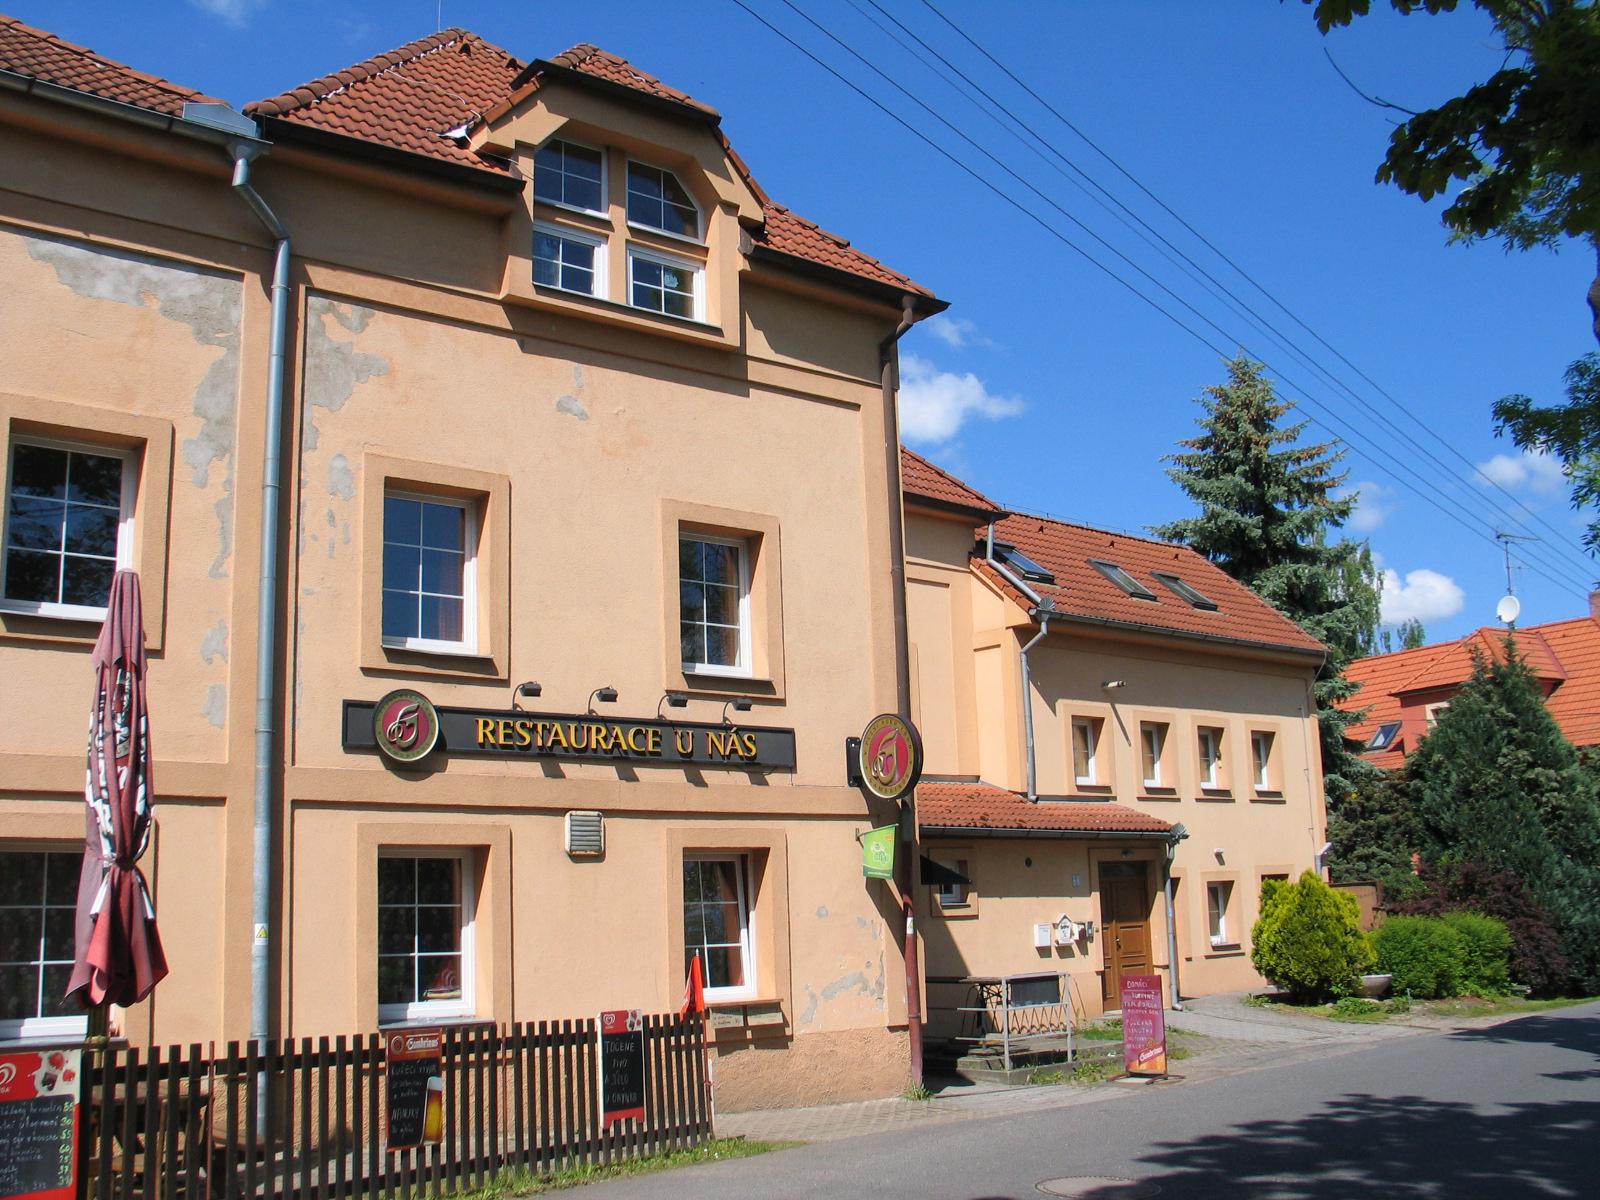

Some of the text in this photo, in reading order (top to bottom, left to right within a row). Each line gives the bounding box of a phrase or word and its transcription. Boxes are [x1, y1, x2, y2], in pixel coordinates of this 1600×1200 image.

[474, 717, 758, 759] RESTAURACE U NÁS
